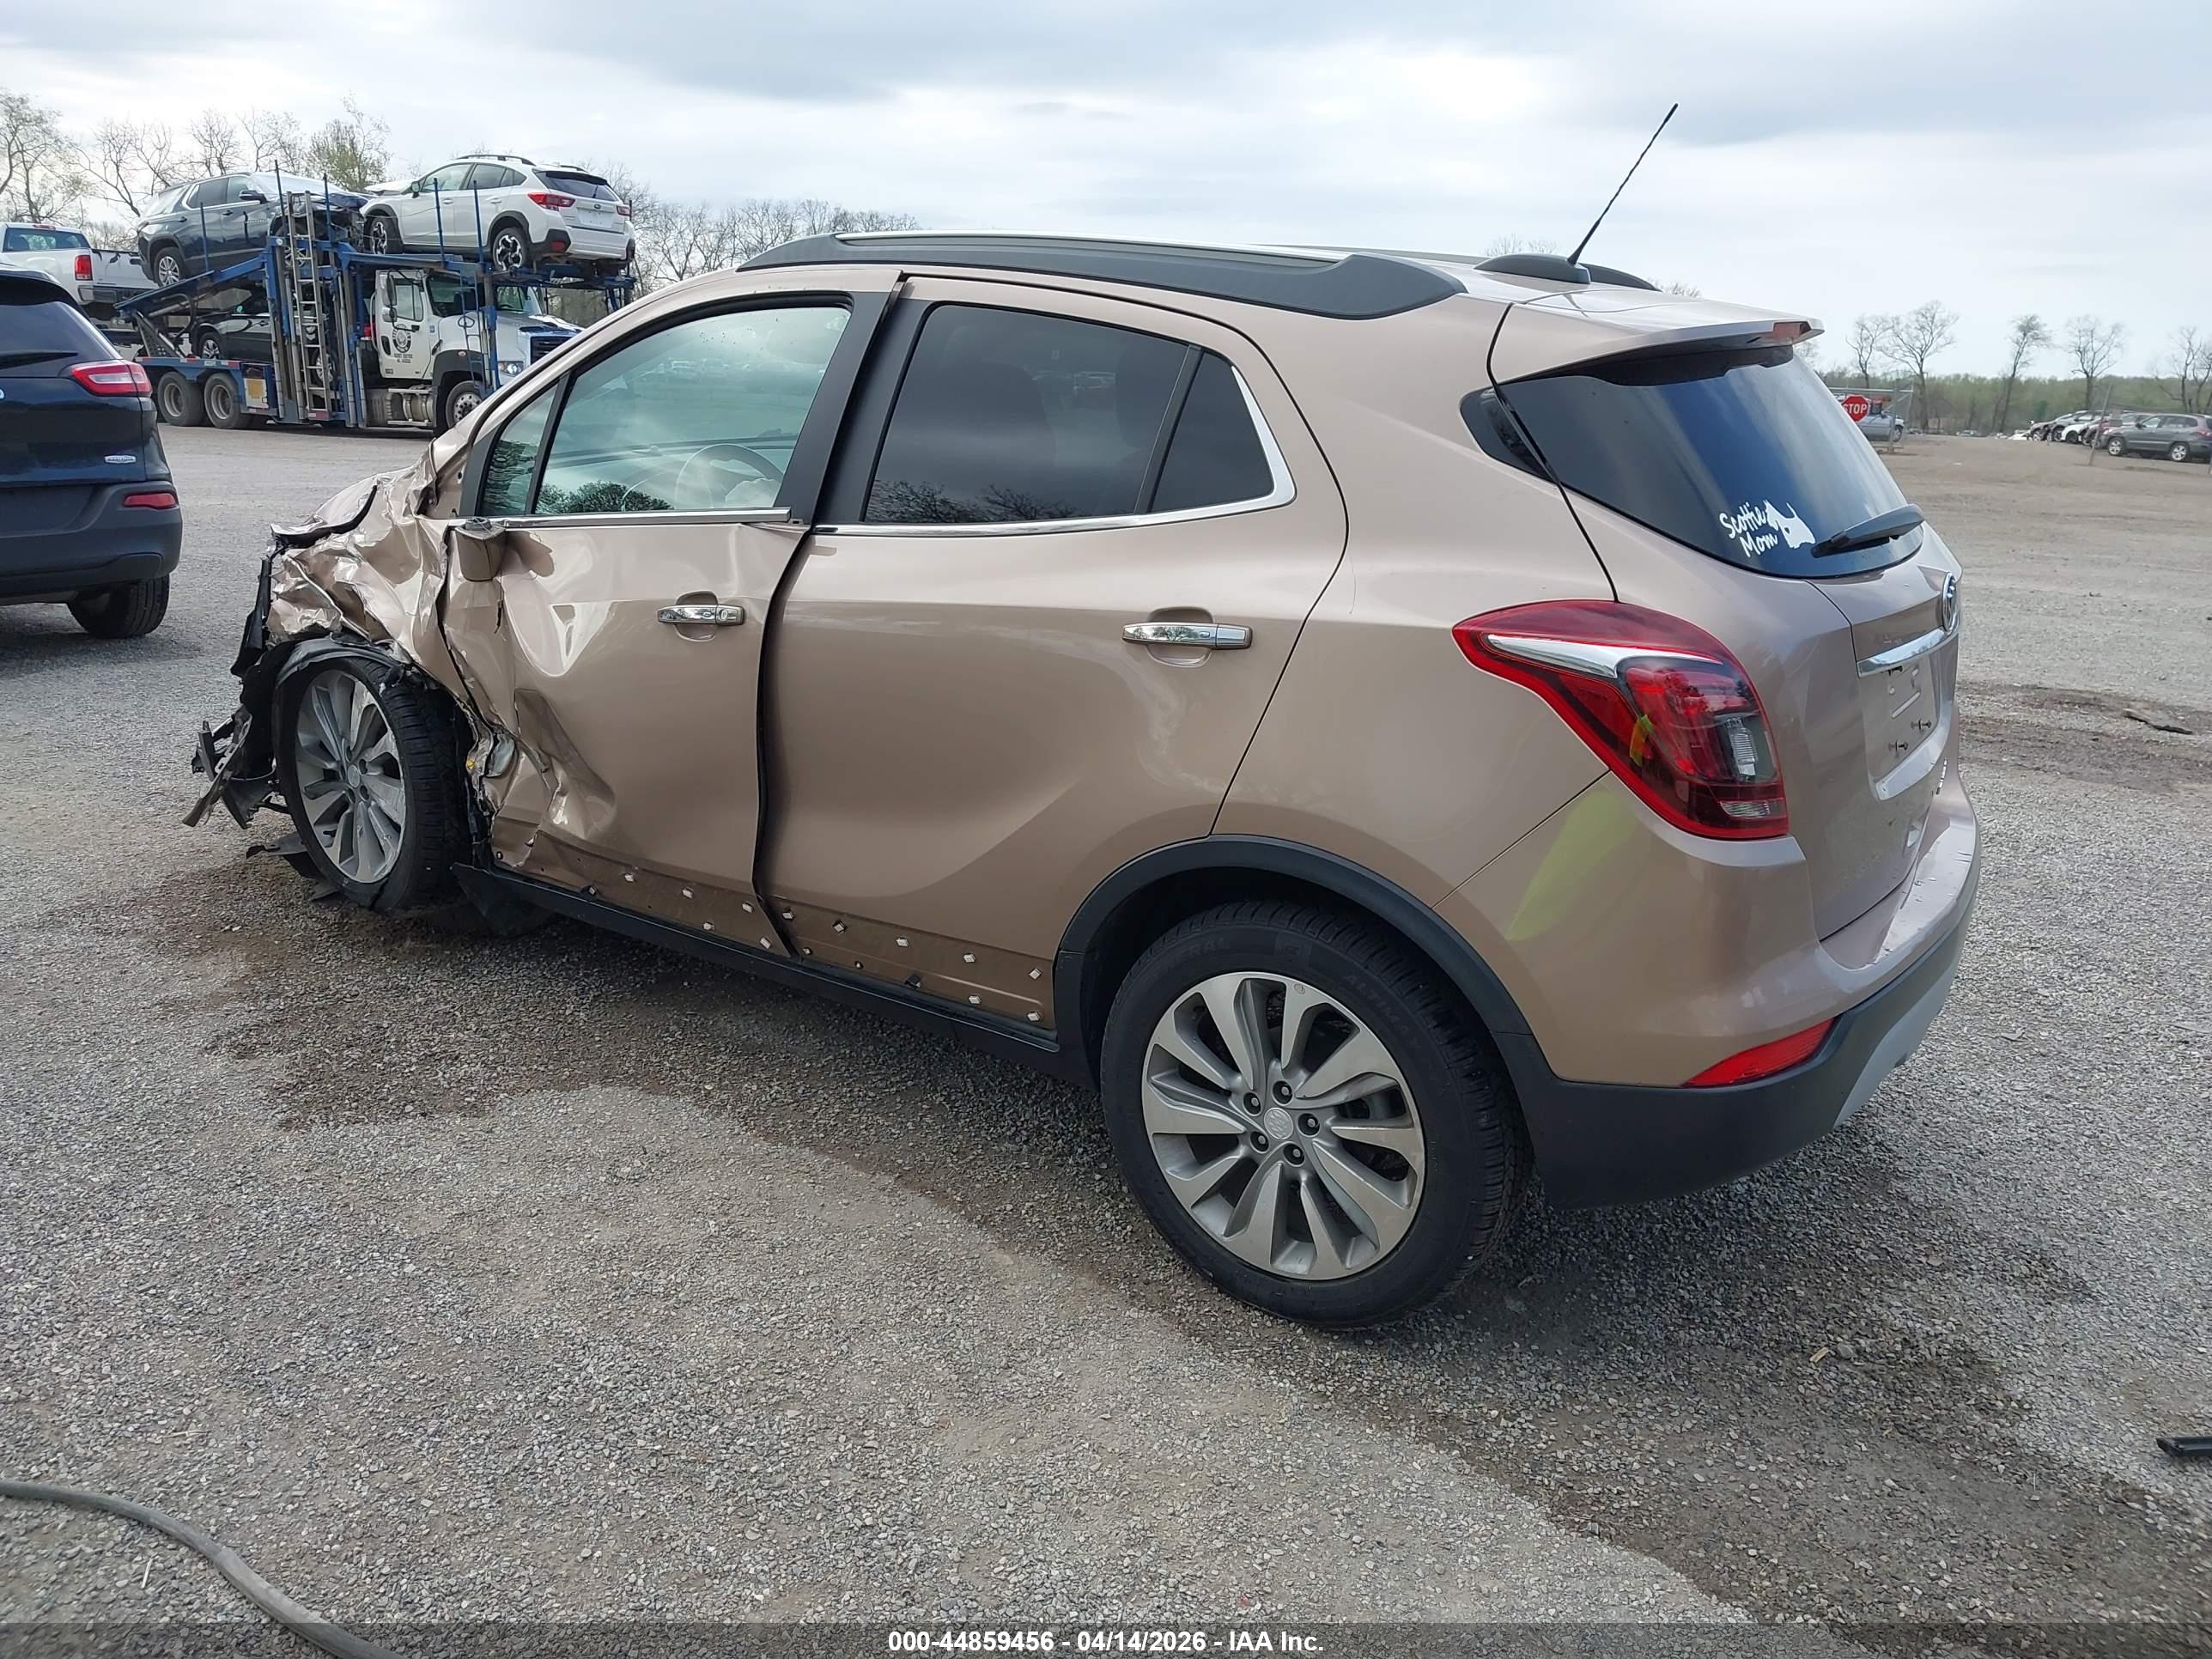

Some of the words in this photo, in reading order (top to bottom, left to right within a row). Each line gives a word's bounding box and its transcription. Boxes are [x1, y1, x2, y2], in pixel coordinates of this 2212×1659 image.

[1843, 404, 1868, 414] STOP
[1719, 501, 1766, 539] Scottie
[1739, 532, 1778, 557] Mom
